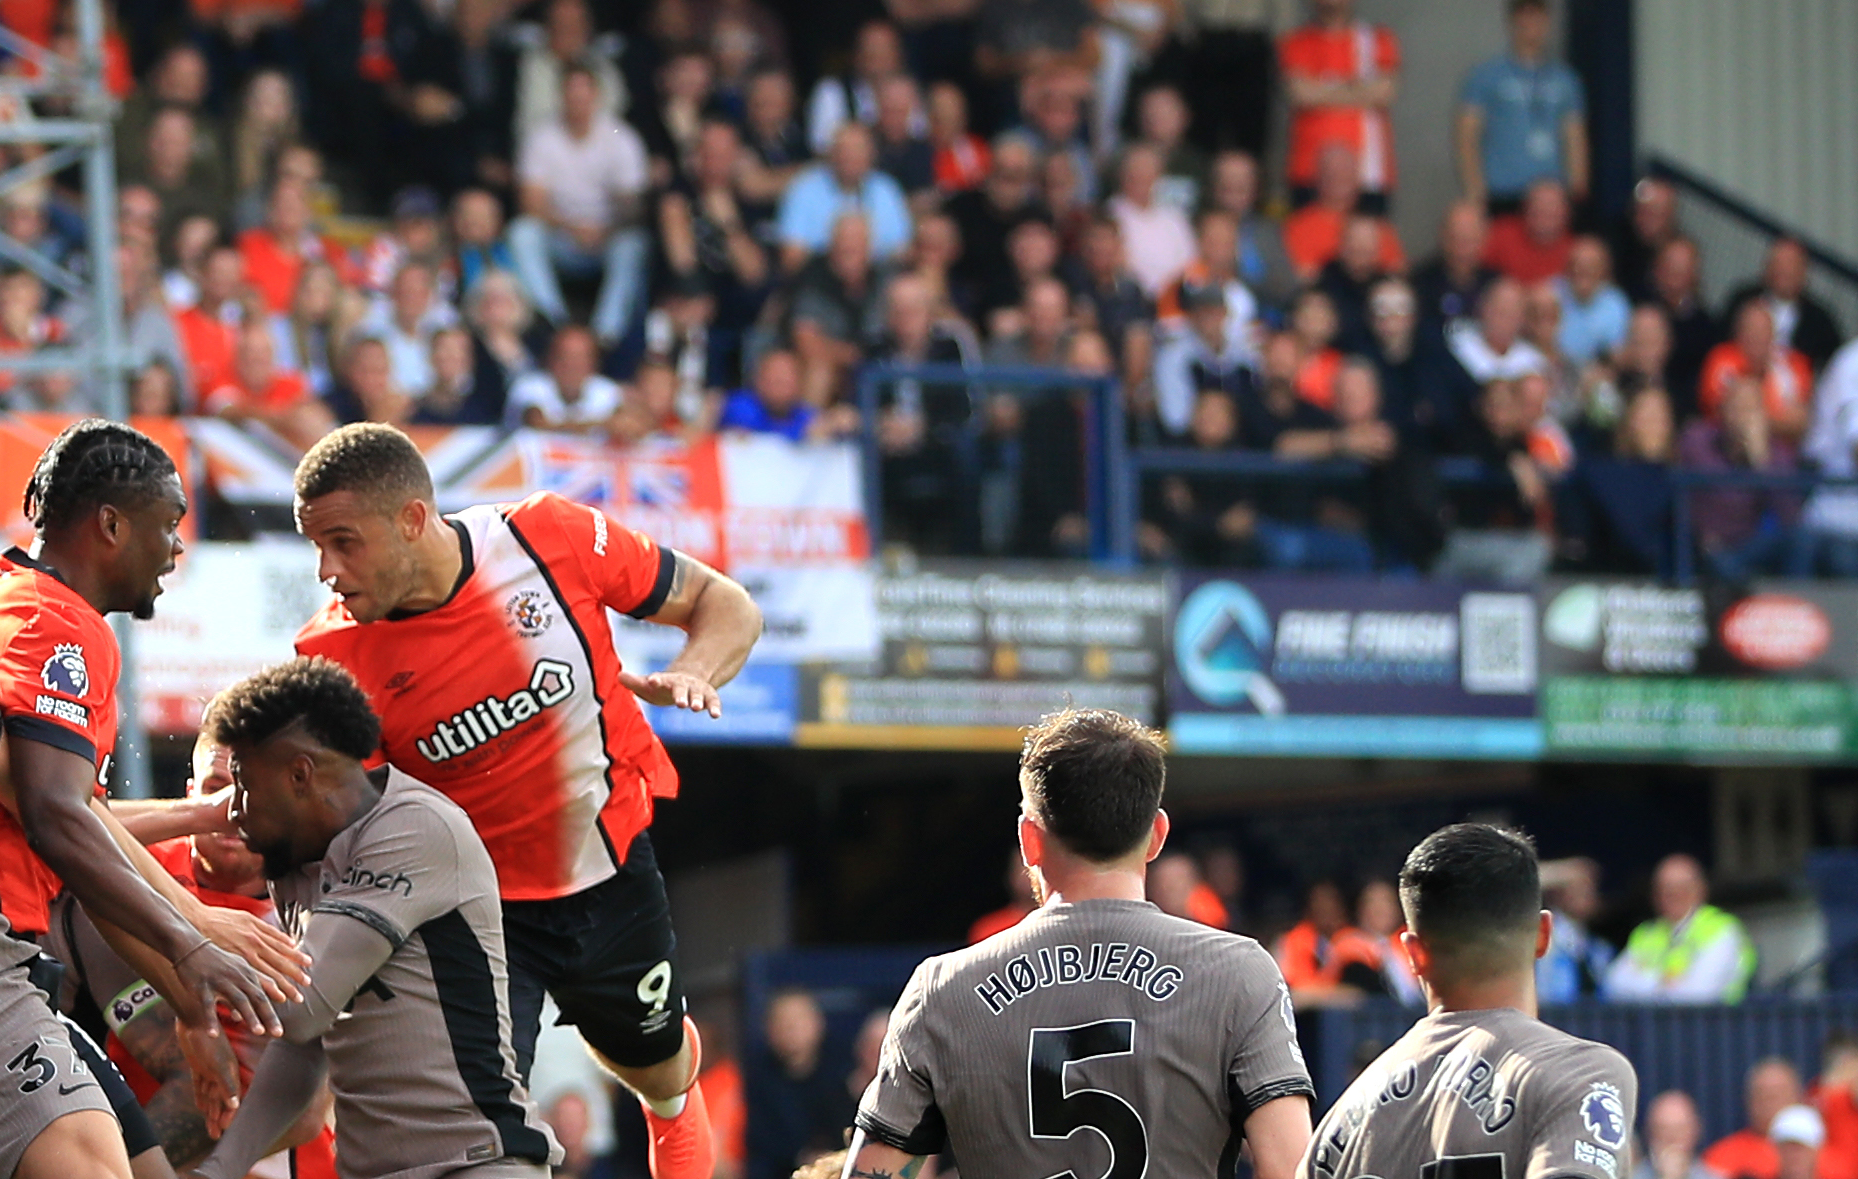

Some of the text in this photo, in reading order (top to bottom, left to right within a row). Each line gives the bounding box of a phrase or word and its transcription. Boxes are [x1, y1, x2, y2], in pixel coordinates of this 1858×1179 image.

[36, 694, 86, 717] No room
[54, 707, 89, 728] racism
[417, 696, 541, 764] utilita
[130, 987, 155, 1004] Ca
[637, 960, 671, 1016] 9
[974, 943, 1184, 1016] HØJBJERG
